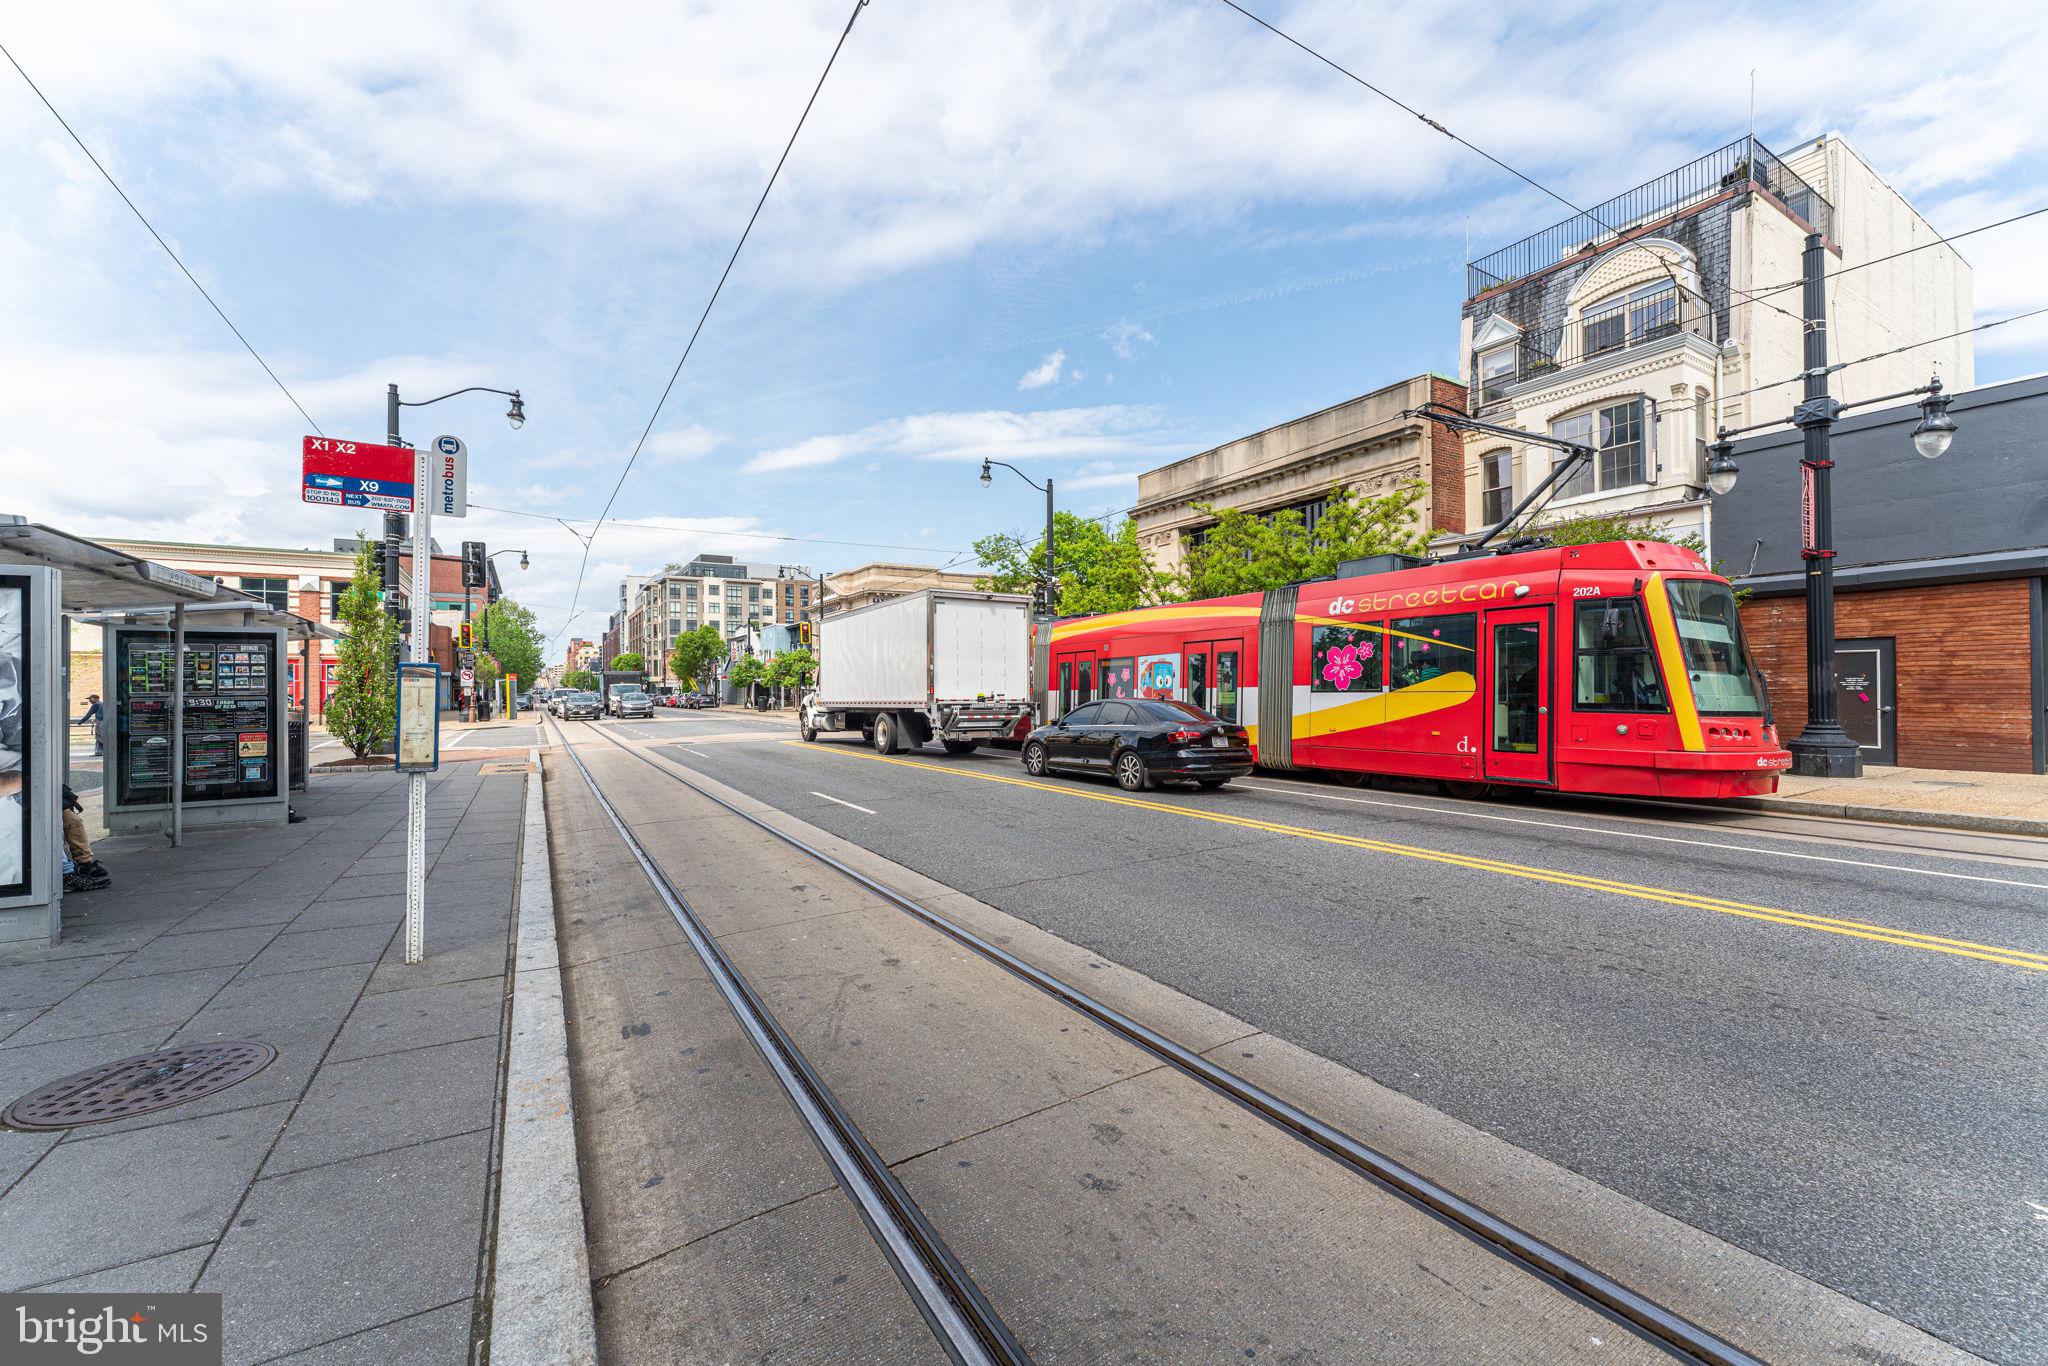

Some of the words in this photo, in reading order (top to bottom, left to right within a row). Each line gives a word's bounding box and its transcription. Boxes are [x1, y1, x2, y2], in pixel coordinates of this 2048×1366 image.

[311, 438, 329, 451] X1
[336, 441, 356, 455] X2
[359, 480, 379, 493] X9
[442, 456, 454, 514] metrobus
[306, 495, 340, 504] 1001143
[371, 501, 410, 511] WMATA.COM
[1328, 596, 1355, 615] dc
[1358, 580, 1520, 613] streetcar
[1572, 586, 1601, 597] 202A
